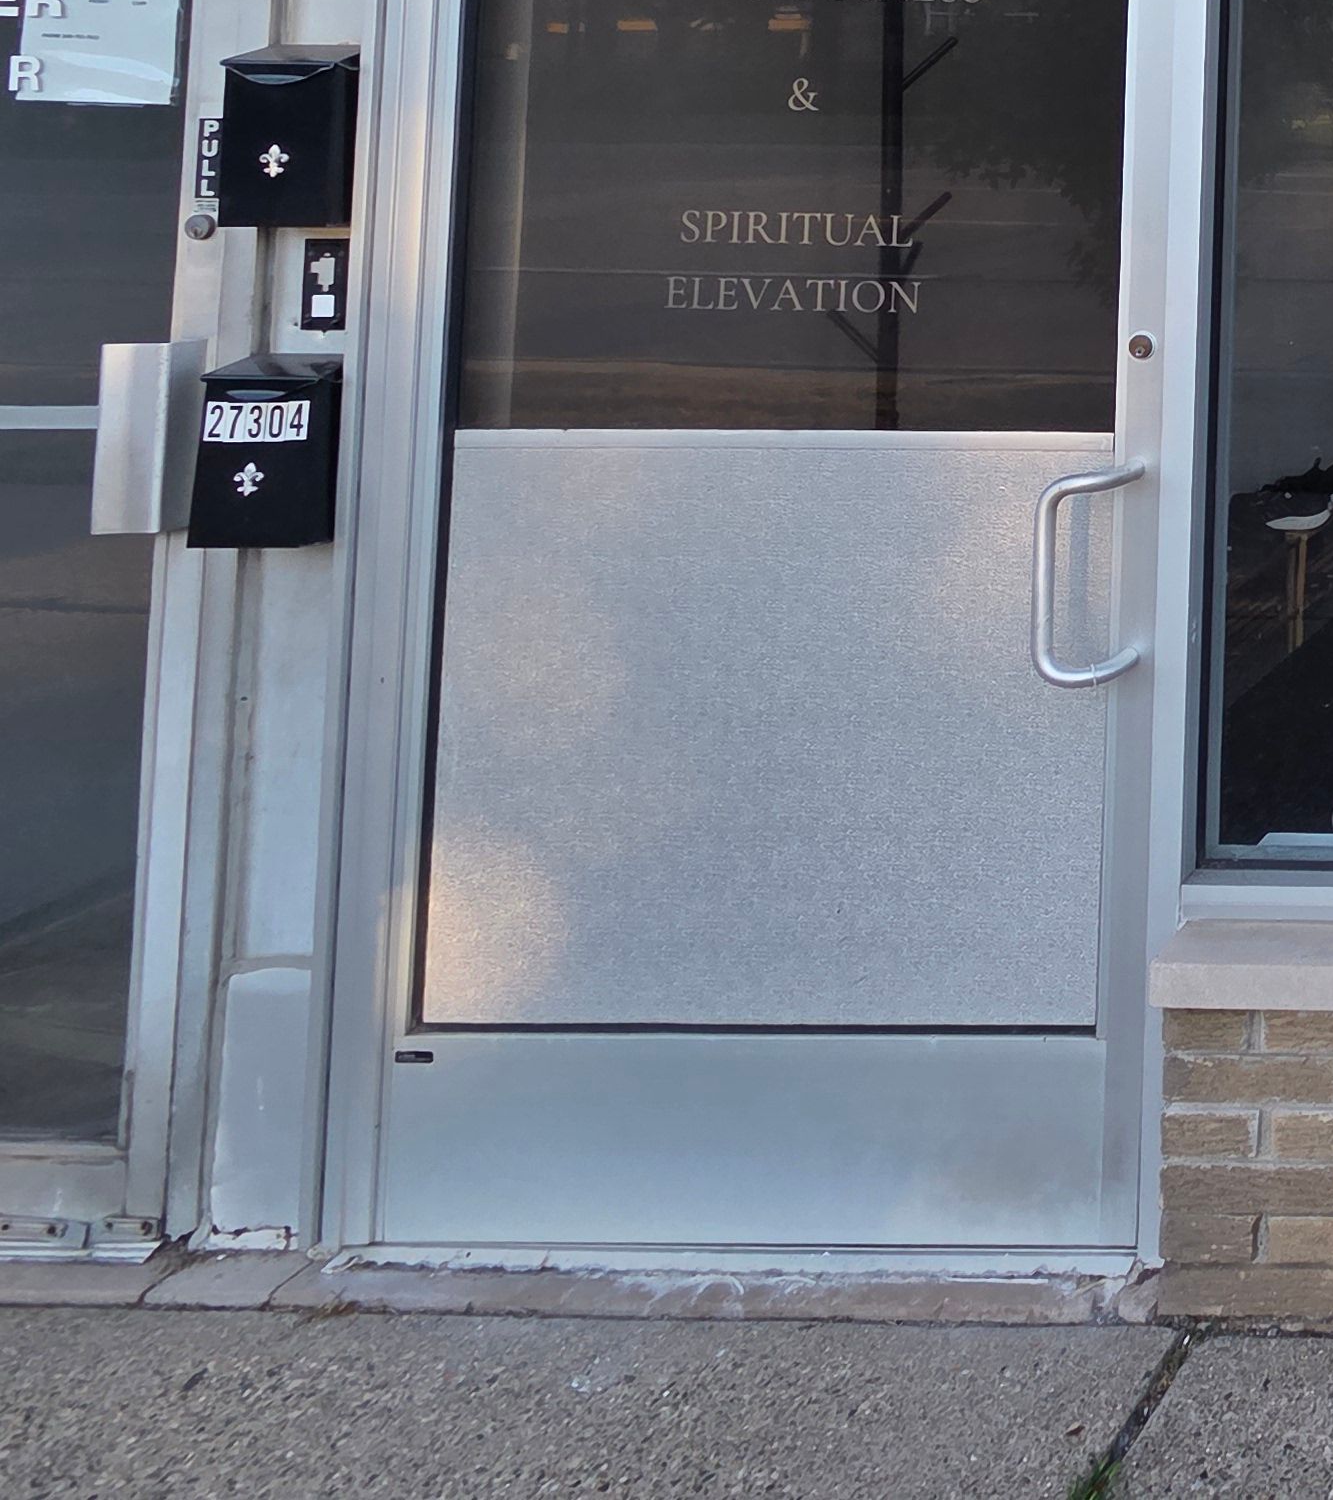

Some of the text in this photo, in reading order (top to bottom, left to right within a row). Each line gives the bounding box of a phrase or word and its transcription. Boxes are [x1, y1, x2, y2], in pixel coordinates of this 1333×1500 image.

[788, 77, 819, 111] &
[200, 119, 220, 197] PULL
[680, 210, 913, 248] SPIRITUAL
[664, 275, 922, 314] ELEVATION
[207, 403, 304, 439] 27304
